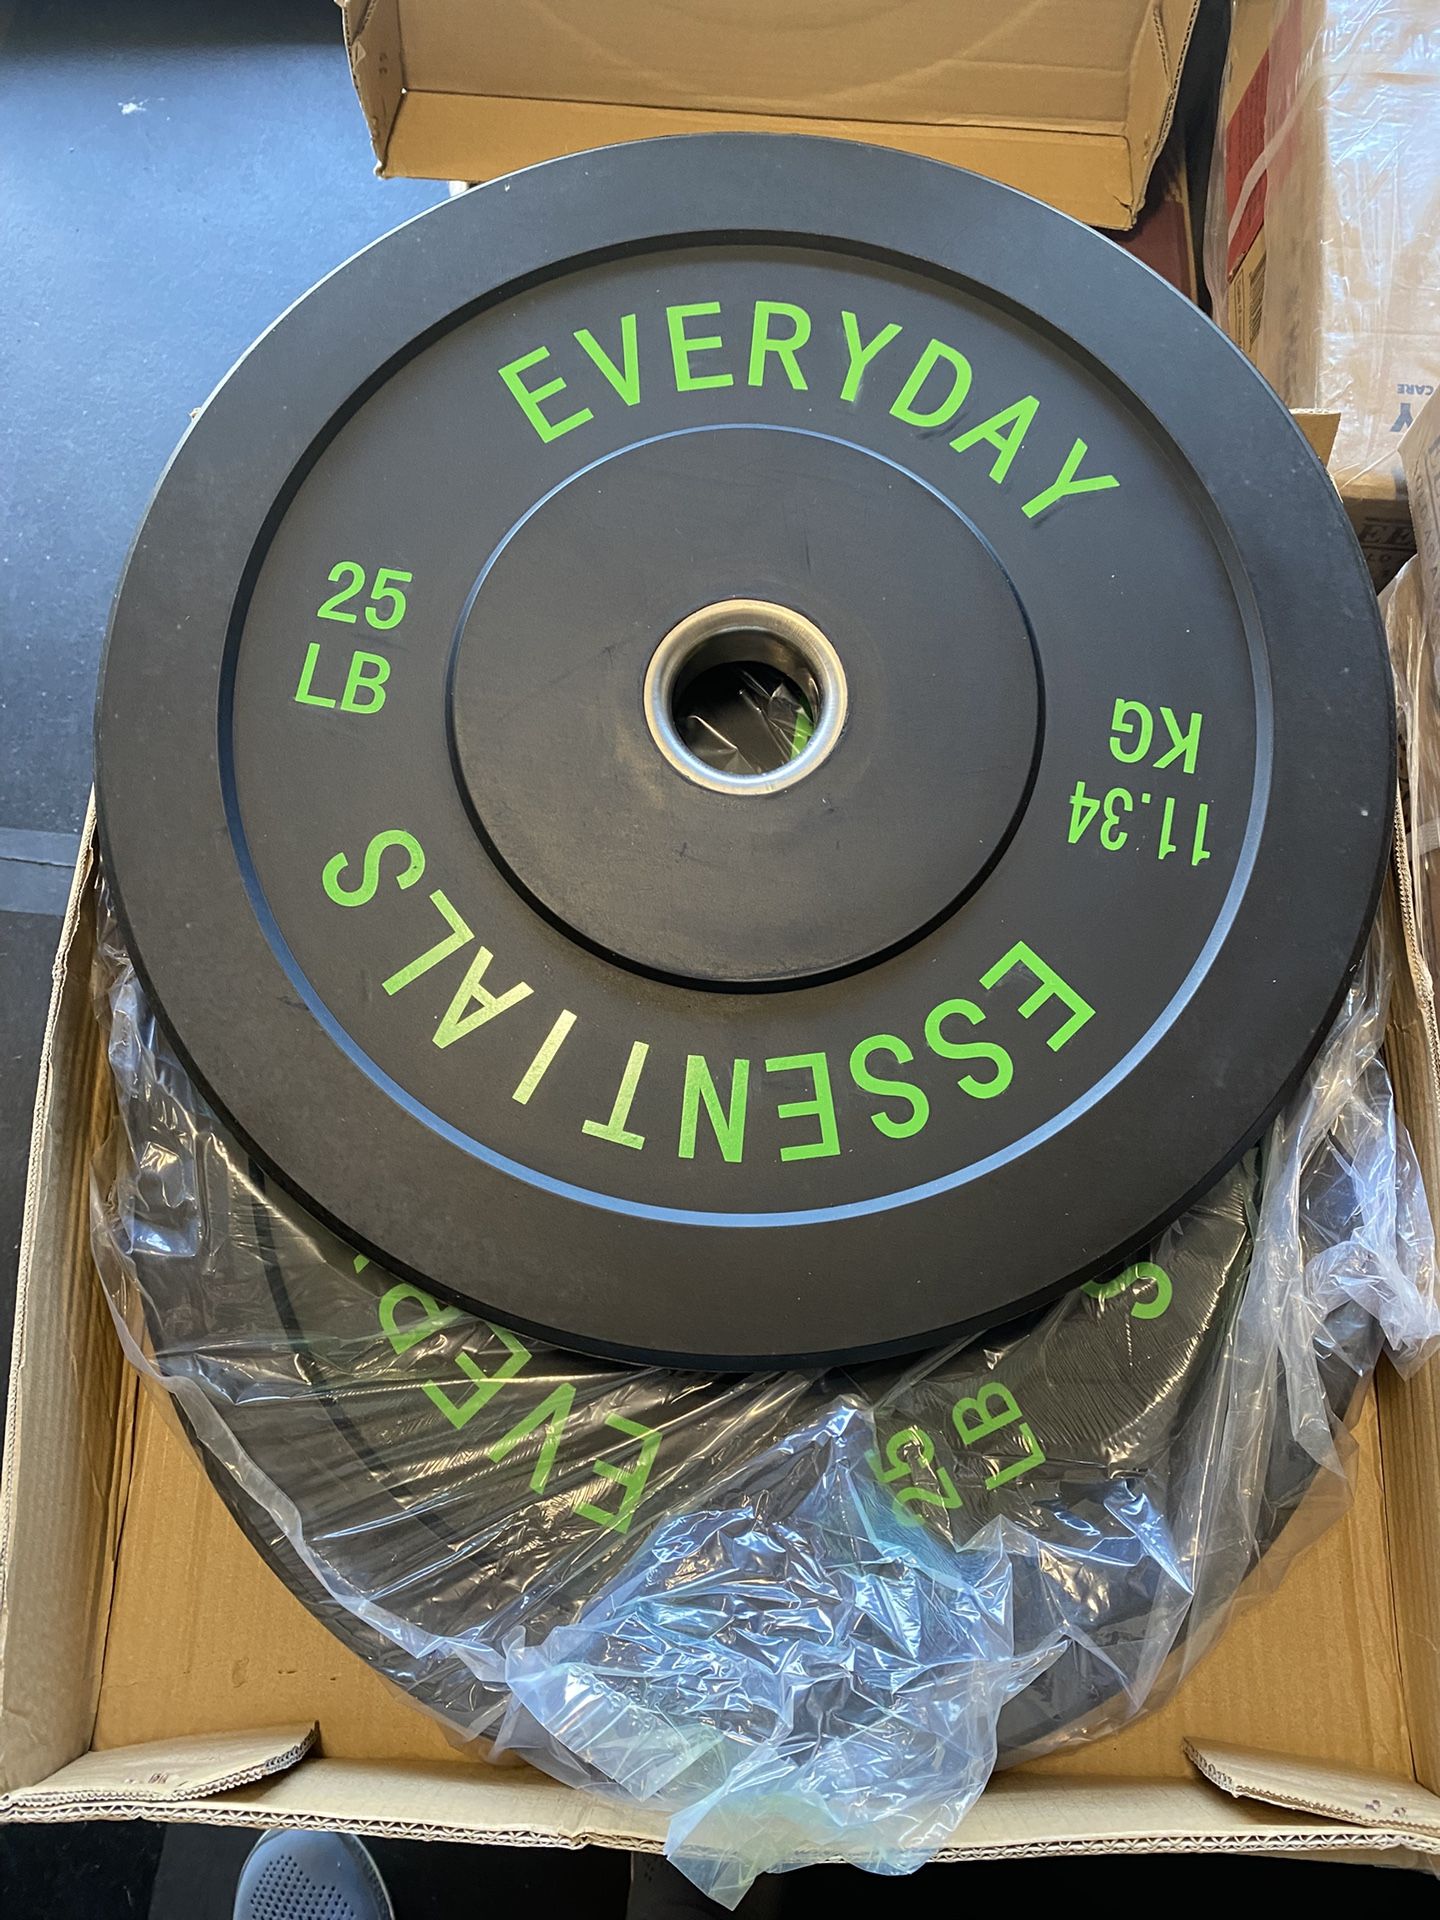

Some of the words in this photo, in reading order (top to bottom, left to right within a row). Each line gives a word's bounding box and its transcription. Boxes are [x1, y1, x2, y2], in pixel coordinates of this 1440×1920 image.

[498, 301, 1118, 520] EVERYDAY
[1396, 384, 1434, 396] CARE
[316, 561, 413, 630] 25
[294, 642, 391, 714] LB
[1109, 698, 1203, 774] KG
[1067, 781, 1211, 866] 11.34
[322, 829, 1096, 1164] ESSENTIALS
[864, 1427, 963, 1528] 25
[952, 1381, 1046, 1489] LB
